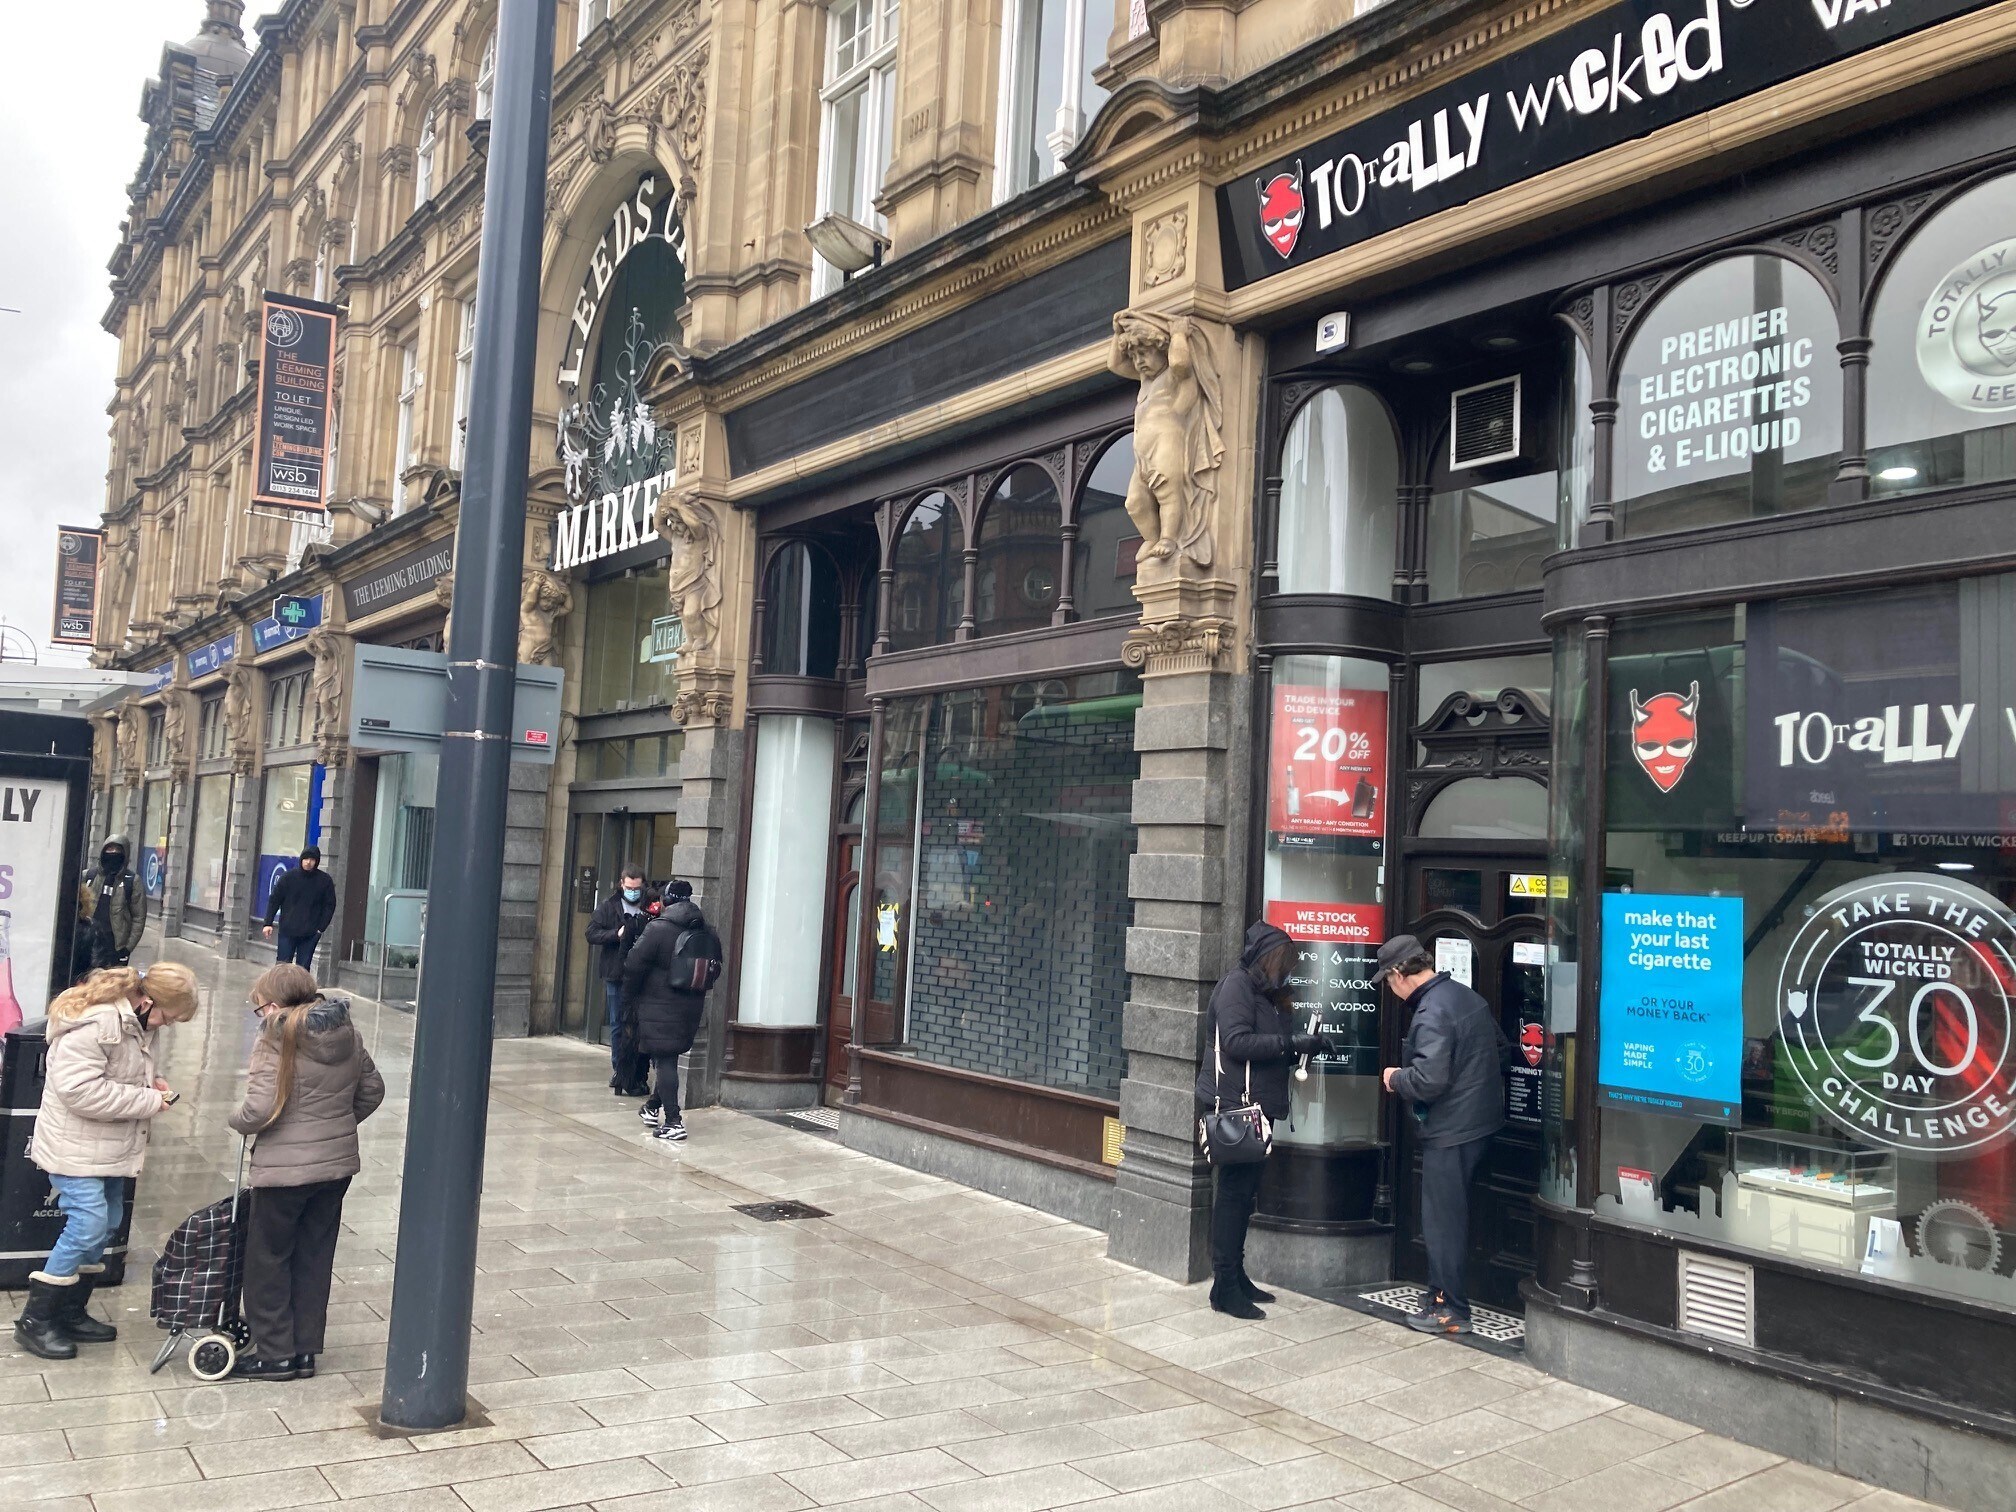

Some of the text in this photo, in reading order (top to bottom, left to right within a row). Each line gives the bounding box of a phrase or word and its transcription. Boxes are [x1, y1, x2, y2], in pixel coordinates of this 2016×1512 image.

[558, 176, 654, 385] LEEDS
[1928, 249, 2007, 338] TOTALLY
[1662, 306, 1789, 365] PREMIER
[277, 350, 298, 361] THE
[276, 362, 322, 377] LEEMING
[1640, 338, 1813, 405] ELECTRONIC
[275, 374, 325, 390] BUILDING
[275, 391, 312, 404] TO LET
[1640, 376, 1811, 439] CIGARETTES
[273, 413, 314, 425] DESIGN LED
[273, 421, 317, 433] WORK SPACE
[1647, 417, 1801, 473] & E-LIQUID
[273, 466, 307, 482] wsb
[354, 550, 452, 606] THE LEEMING BUILDING
[1284, 694, 1316, 704] TRADE
[1329, 697, 1355, 706] YOUR
[1284, 704, 1341, 715] OLD DEVICE
[1348, 749, 1371, 760] OFF
[1717, 832, 1818, 844] KEEP UP TO DATE
[1910, 834, 1978, 847] TOTALLY
[1297, 910, 1356, 923] WE STOCK
[1624, 909, 1716, 929] make that
[1832, 893, 1989, 938] TAKE THE
[1283, 923, 1370, 936] THESE BRANDS
[1630, 931, 1710, 950] your last
[1860, 941, 1955, 962] TOTALLY
[1628, 949, 1712, 971] cigarette
[1864, 958, 1952, 979] WICKED
[1329, 978, 1376, 991] SMOK
[1291, 1001, 1323, 1010] ngertech
[1330, 1001, 1376, 1012] VOOPOO
[1641, 996, 1694, 1011] OR YOUR
[1626, 1006, 1670, 1020] MONEY
[1843, 977, 1978, 1076] 30
[1623, 1042, 1655, 1053] VAPING
[1623, 1051, 1648, 1060] MADE
[1623, 1059, 1653, 1069] SIMPLE
[1685, 1055, 1705, 1072] 30
[1883, 1072, 1935, 1094] DAY
[1822, 1077, 2008, 1139] CHALLENGE
